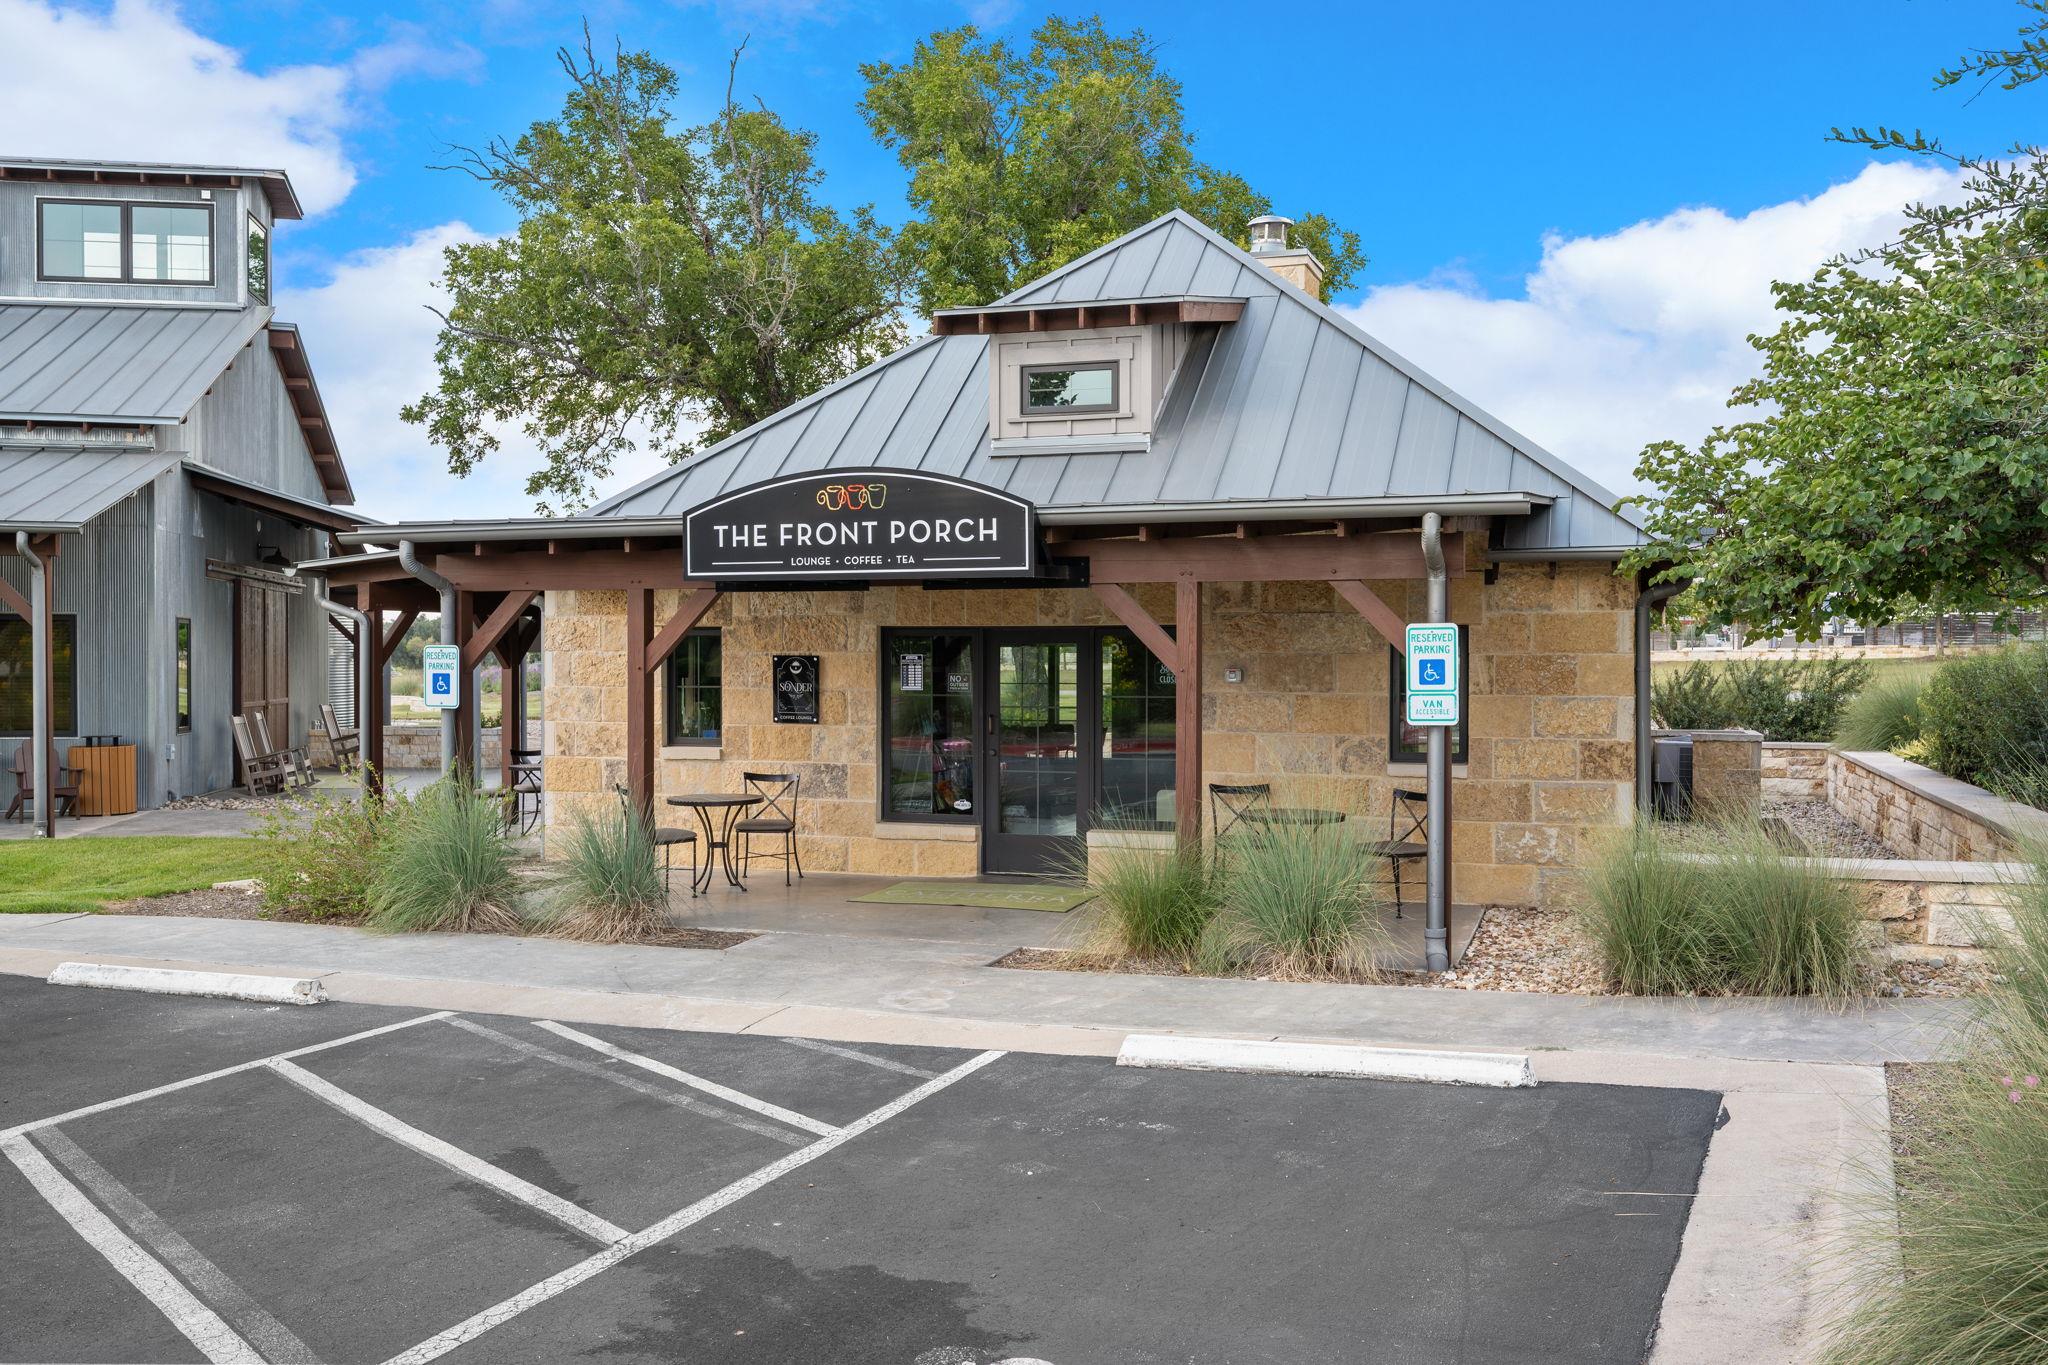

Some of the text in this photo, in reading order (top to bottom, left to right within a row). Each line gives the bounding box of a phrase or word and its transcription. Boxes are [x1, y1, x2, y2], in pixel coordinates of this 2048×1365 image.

[713, 517, 998, 548] THE FRONT PORCH
[790, 555, 915, 566] LOUNGE COFFEE TEA
[1411, 633, 1453, 643] RESERVED
[1413, 645, 1450, 654] PARKING
[426, 652, 456, 660] RESERVED
[780, 681, 812, 693] SONDER
[1422, 700, 1443, 708] VAN
